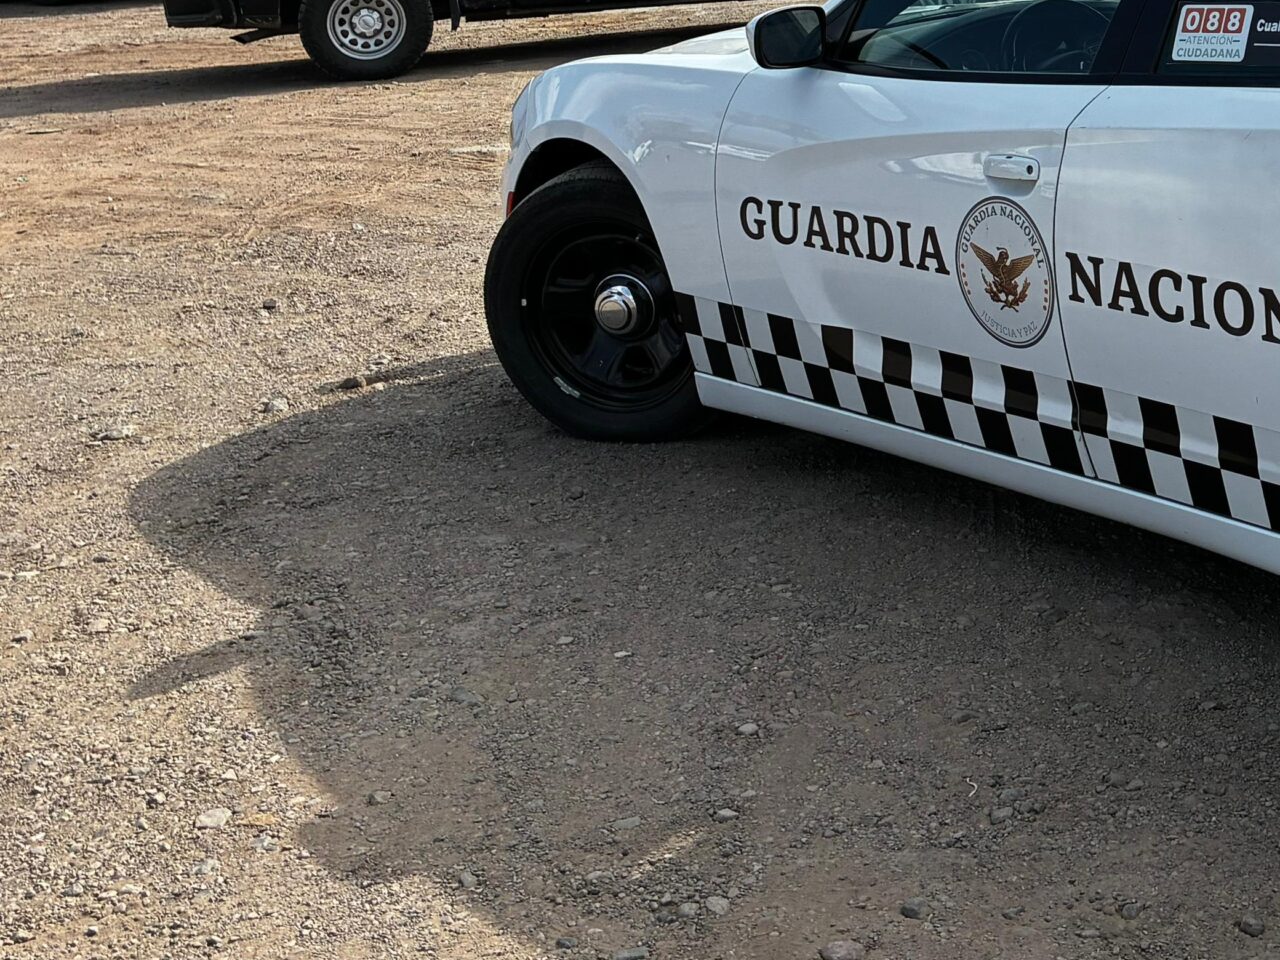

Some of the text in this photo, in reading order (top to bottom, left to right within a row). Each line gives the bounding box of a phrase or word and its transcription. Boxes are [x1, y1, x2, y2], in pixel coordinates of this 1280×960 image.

[1186, 11, 1241, 31] 088
[1176, 47, 1241, 59] CIUDADANA
[740, 196, 950, 275] GUARDIA
[961, 205, 1045, 269] GUARDIA NACIONAL
[980, 310, 1018, 338] JUSTICIA
[1023, 321, 1038, 336] PAZ
